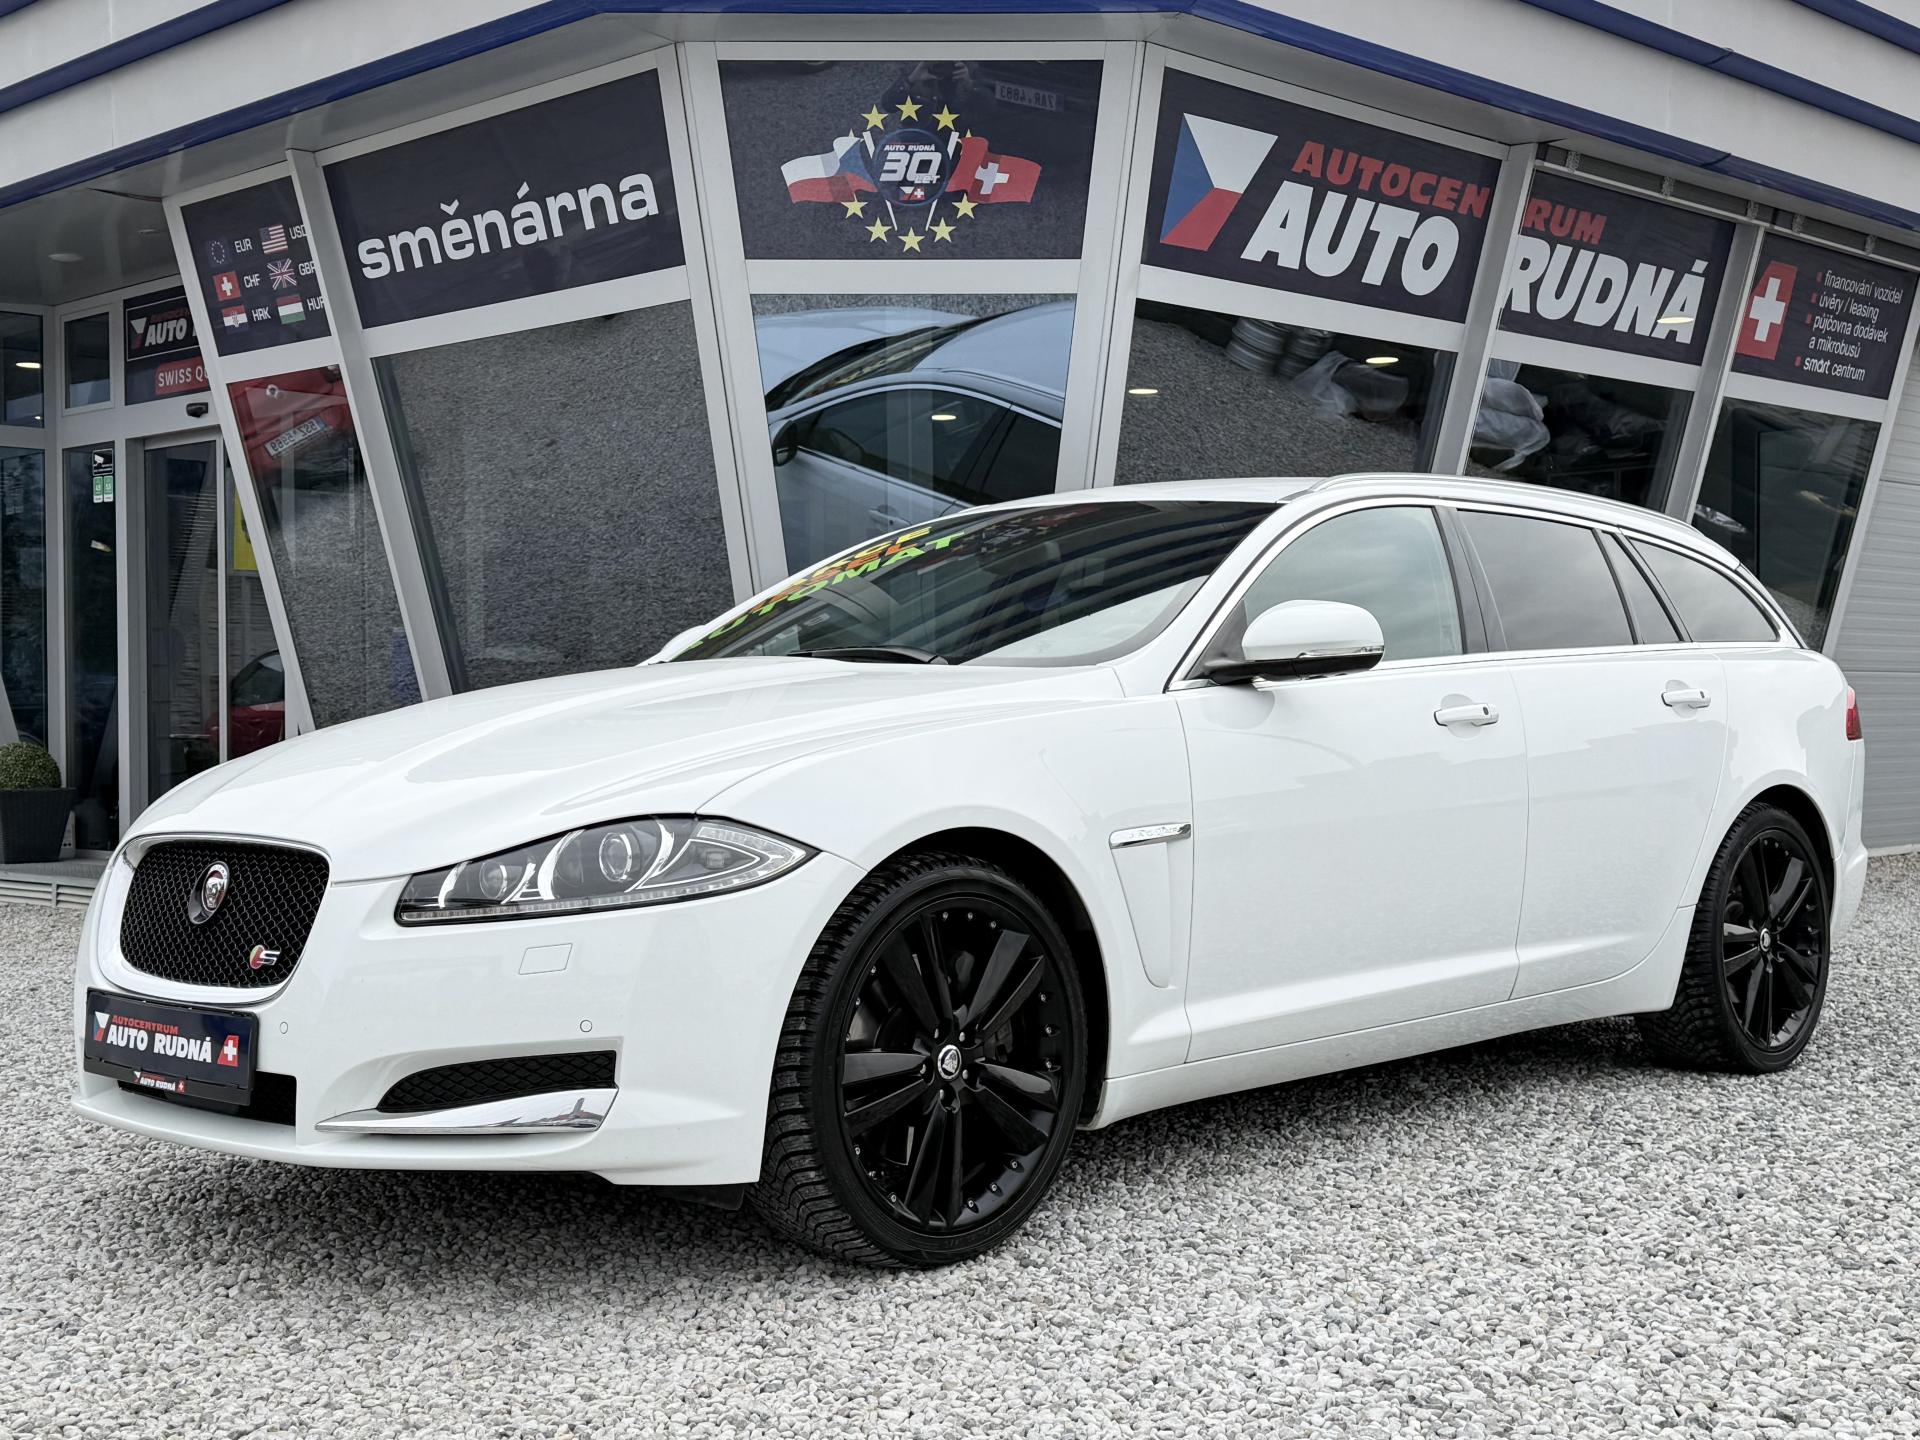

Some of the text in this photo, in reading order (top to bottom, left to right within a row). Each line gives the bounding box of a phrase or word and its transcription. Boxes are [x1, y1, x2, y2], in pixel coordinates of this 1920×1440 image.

[879, 152, 942, 182] 30
[358, 173, 660, 279] směnárna
[234, 238, 253, 253] EUR
[1240, 180, 1709, 344] AUTO RUDNÁ
[243, 274, 260, 288] CHF
[1824, 270, 1904, 304] financování vozidel
[252, 306, 271, 321] HRK
[1819, 292, 1845, 314] úvěry
[1849, 299, 1879, 323] leasing
[145, 318, 188, 347] AUTO
[1809, 336, 1816, 349] a
[1813, 313, 1888, 343] půjčovna dodávek
[158, 367, 192, 387] SWISS
[1803, 357, 1866, 381] smart centrum
[112, 1014, 179, 1035] AUTOCENTRUM
[106, 1024, 212, 1063] AUTO RUDNÁ
